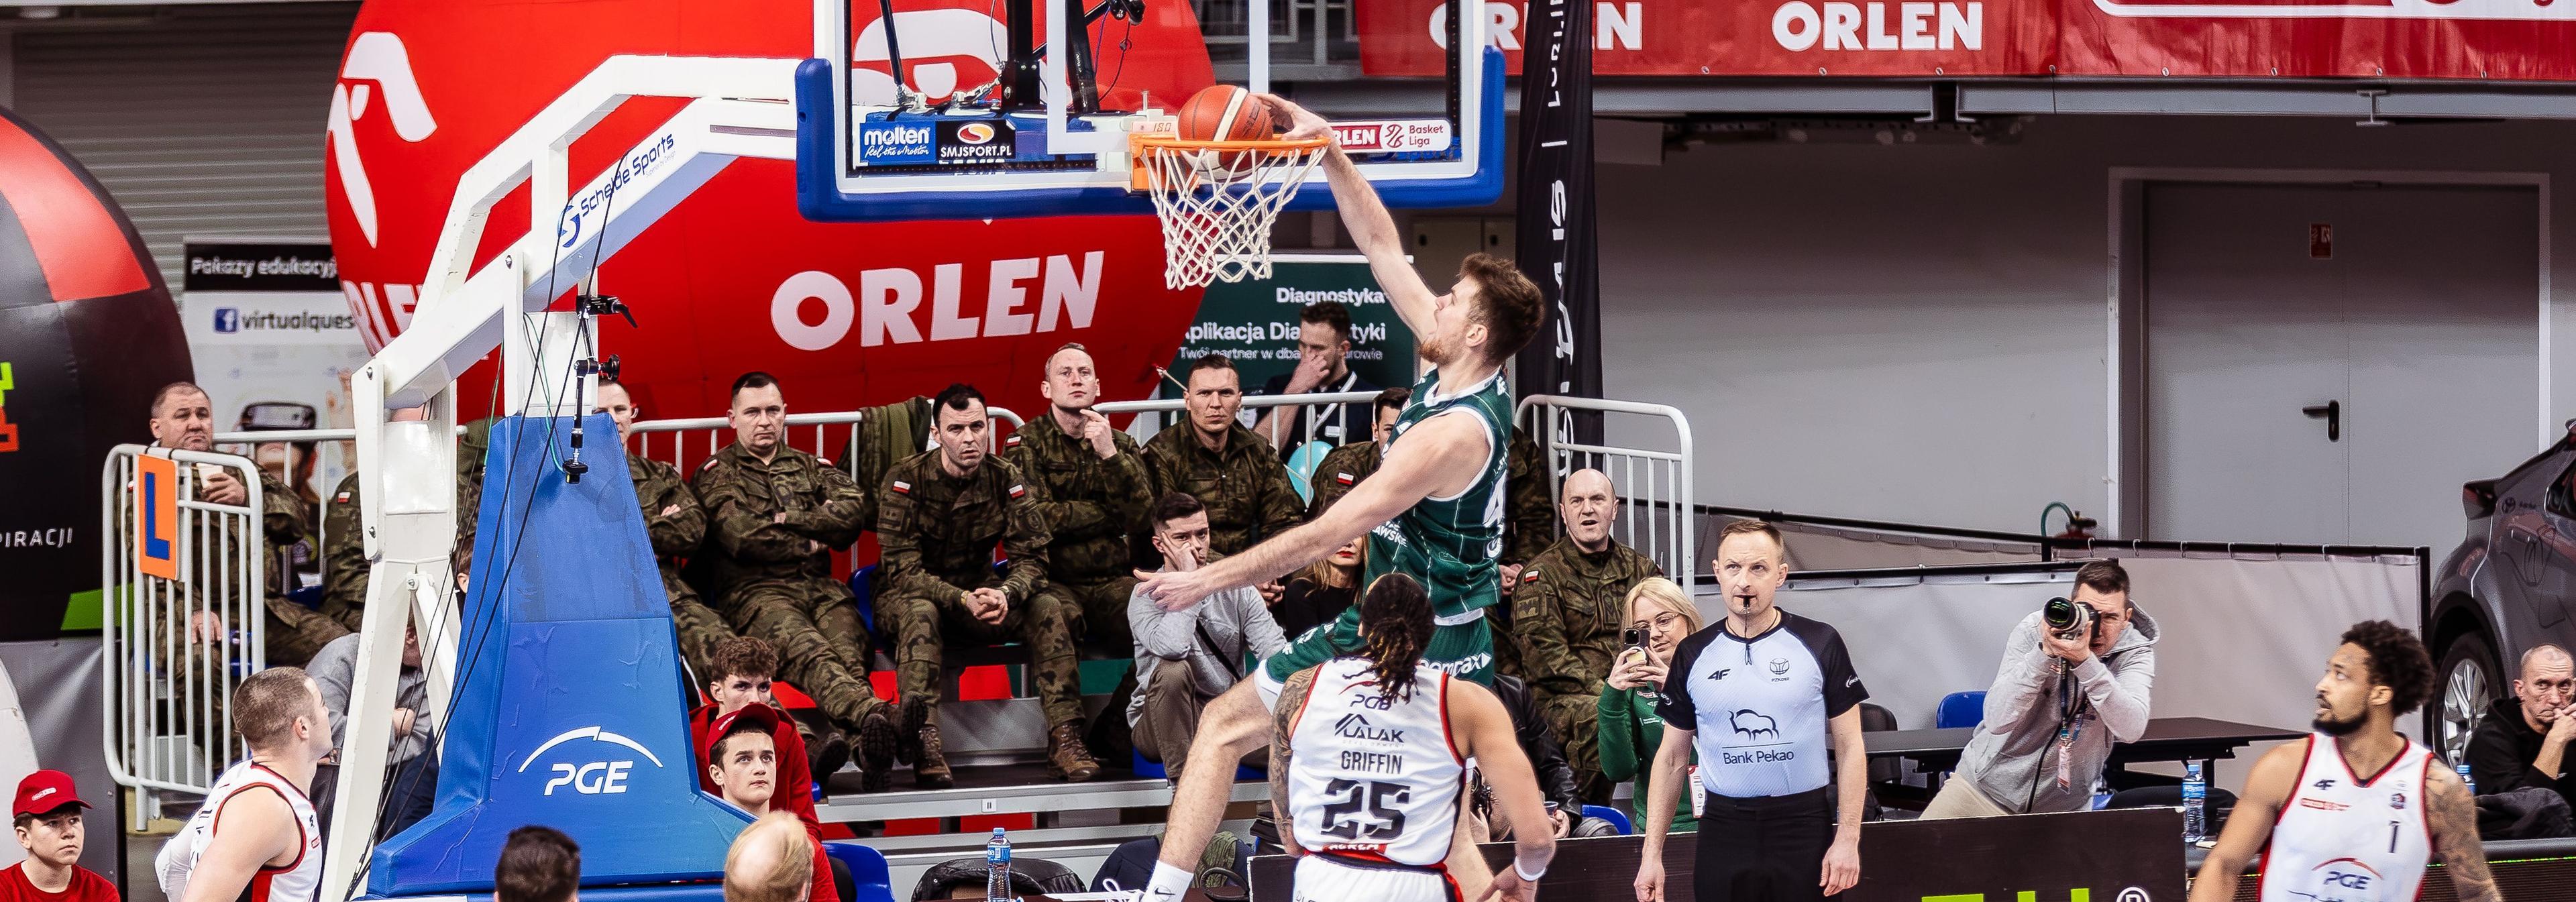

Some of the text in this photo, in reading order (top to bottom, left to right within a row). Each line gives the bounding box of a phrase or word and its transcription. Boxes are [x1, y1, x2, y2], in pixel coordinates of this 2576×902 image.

[1772, 1, 1984, 52] ORLEN
[864, 127, 929, 146] molten
[1409, 125, 1444, 134] Basket
[941, 146, 1012, 158] SMJSPORT.PL
[1409, 136, 1430, 148] Liga
[580, 133, 674, 217] Schelde Sports
[770, 250, 1105, 351] ORLEN
[1276, 287, 1386, 306] Diagnostyka
[1185, 322, 1386, 345] plikacja Diatyki
[145, 471, 170, 560] L
[0, 528, 73, 548] IRACJI
[1708, 669, 1731, 680] 4F
[1341, 750, 1402, 775] GRIFFIN
[1723, 749, 1794, 765] Bank Pekao
[543, 760, 634, 797] PGE
[1320, 777, 1411, 840] 25
[2388, 820, 2401, 854] 1
[2323, 870, 2372, 890] PGE
